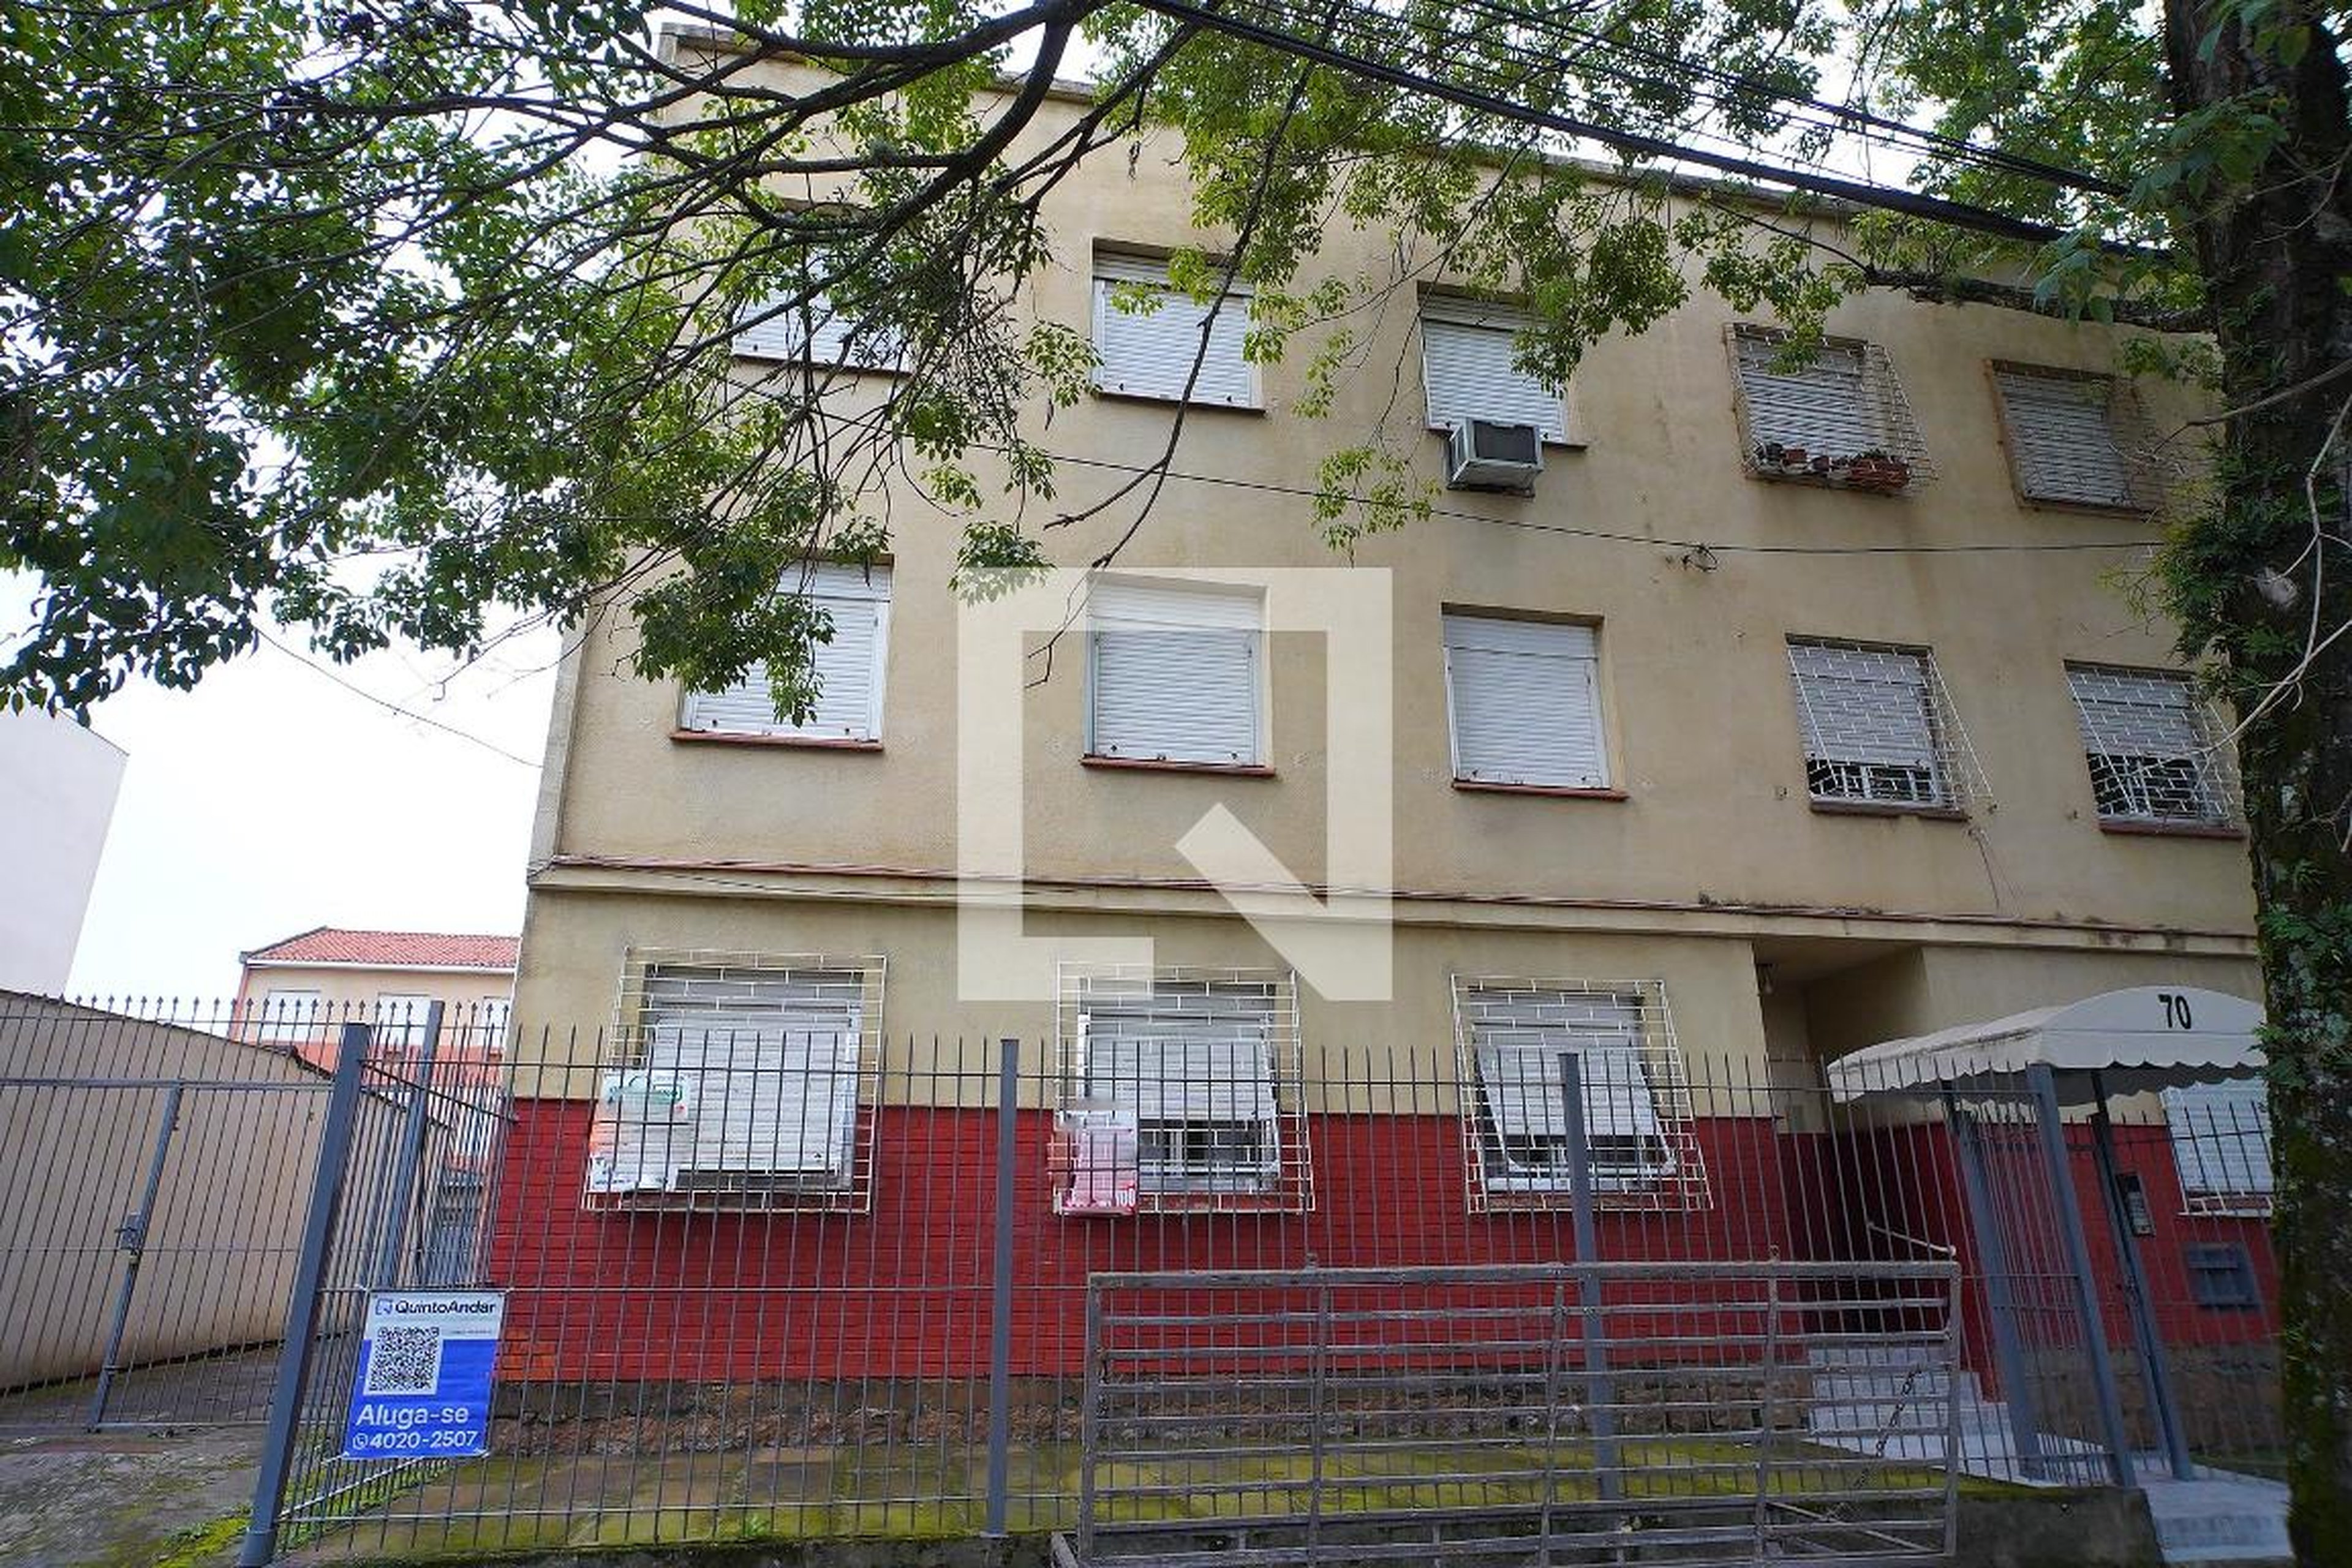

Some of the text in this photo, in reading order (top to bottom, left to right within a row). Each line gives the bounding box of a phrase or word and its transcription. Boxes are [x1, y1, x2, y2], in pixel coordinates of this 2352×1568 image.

[2157, 993, 2192, 1030] 70
[395, 1299, 496, 1314] QuintoAndar
[356, 1404, 469, 1430] Aluga-se
[370, 1431, 478, 1449] 4020-2507
